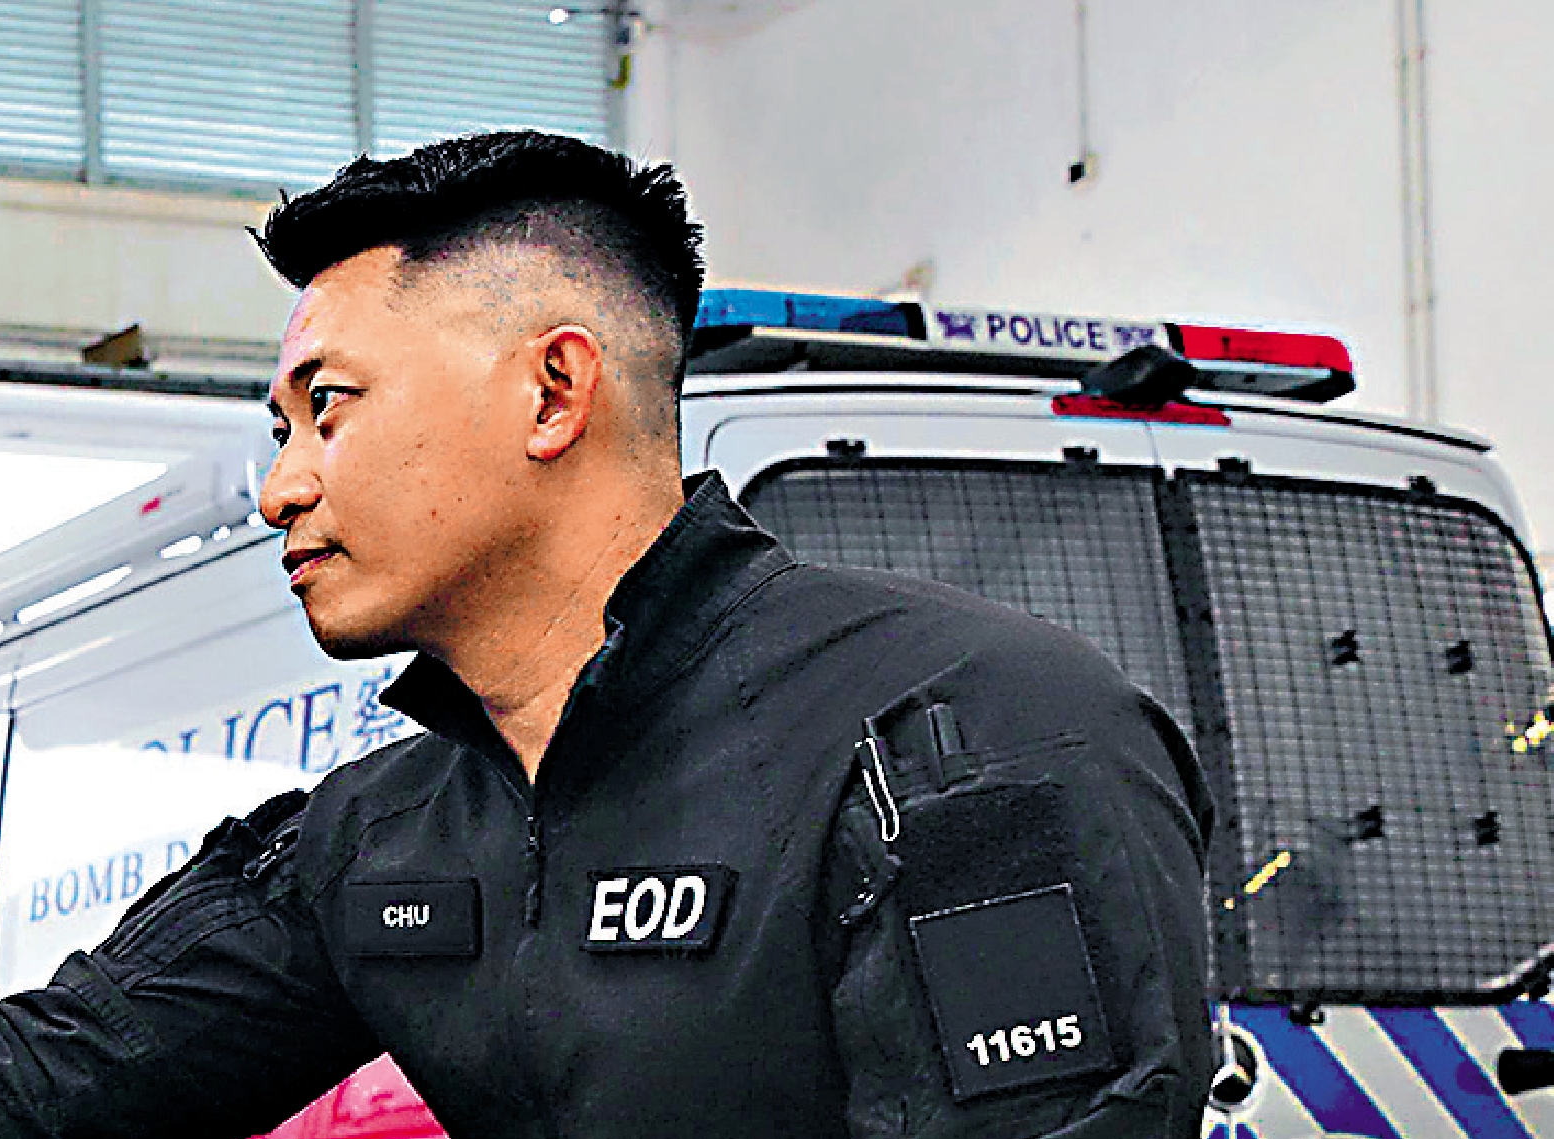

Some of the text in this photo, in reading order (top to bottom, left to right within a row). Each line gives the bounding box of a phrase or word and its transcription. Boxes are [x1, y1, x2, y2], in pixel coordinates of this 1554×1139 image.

[987, 314, 1107, 350] POLICE
[29, 852, 145, 923] BOMB
[590, 876, 707, 941] EOD
[382, 905, 430, 927] CHU
[966, 1014, 1082, 1066] 11615
